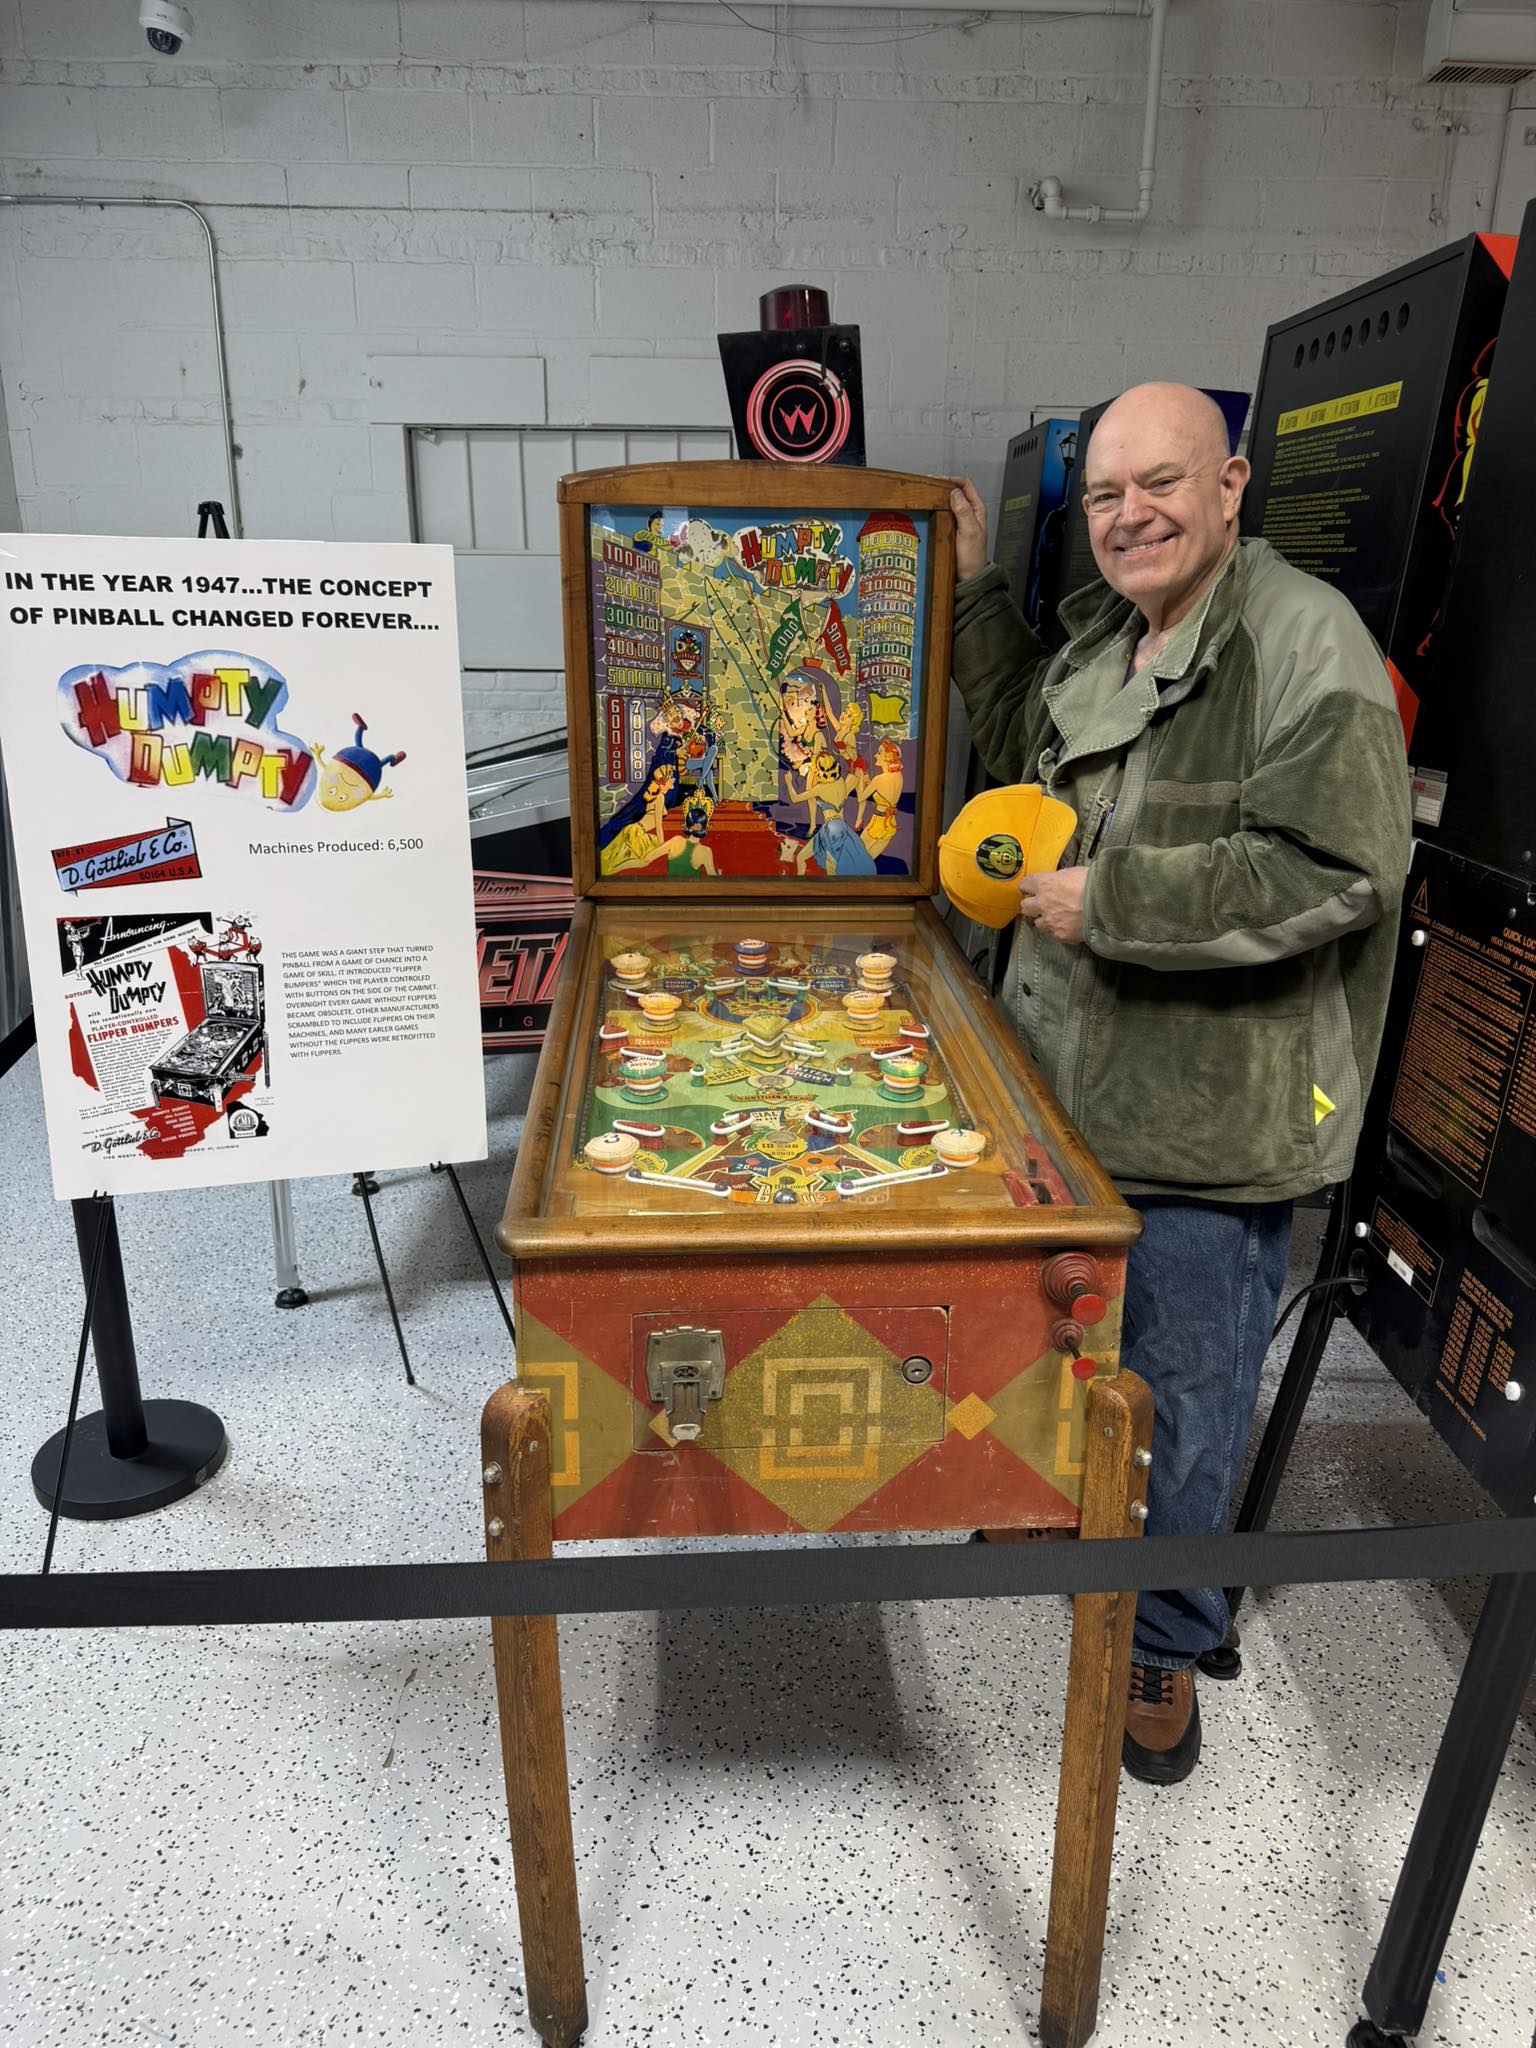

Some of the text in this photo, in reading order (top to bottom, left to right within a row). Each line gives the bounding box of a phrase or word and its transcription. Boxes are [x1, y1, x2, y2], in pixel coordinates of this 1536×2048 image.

[740, 524, 840, 568] HUMPTY
[6, 572, 33, 591] IN
[41, 573, 94, 591] THE
[103, 574, 173, 593] YEAR
[320, 579, 432, 598] CONCEPT
[10, 607, 439, 631] OF PINBALL CHANGED FOREVER....
[74, 668, 283, 747] HUMPTY
[128, 730, 313, 806] DUMPTY
[249, 838, 423, 855] Machines Produced: 6,500
[62, 867, 83, 885] D.
[85, 842, 146, 882] Gottlieb
[163, 831, 188, 855] Co.
[473, 878, 528, 896] illiams
[1503, 928, 1536, 950] QUICK LOC
[86, 960, 152, 998] HUMPTY
[64, 989, 93, 1000] GOTTLIEB
[109, 981, 166, 1014] DUMPTY
[286, 1001, 326, 1009] OVERNIGHT
[380, 1004, 439, 1013] MANUFACTURERS
[87, 1016, 180, 1043] FLIPPER BUMPERS
[288, 1021, 330, 1029] SCRAMBLED
[392, 1033, 435, 1041] RETROFITTED
[311, 1049, 343, 1057] FLIPPERS.
[708, 1068, 745, 1081] SPECIAL
[786, 1070, 833, 1083] CROWN
